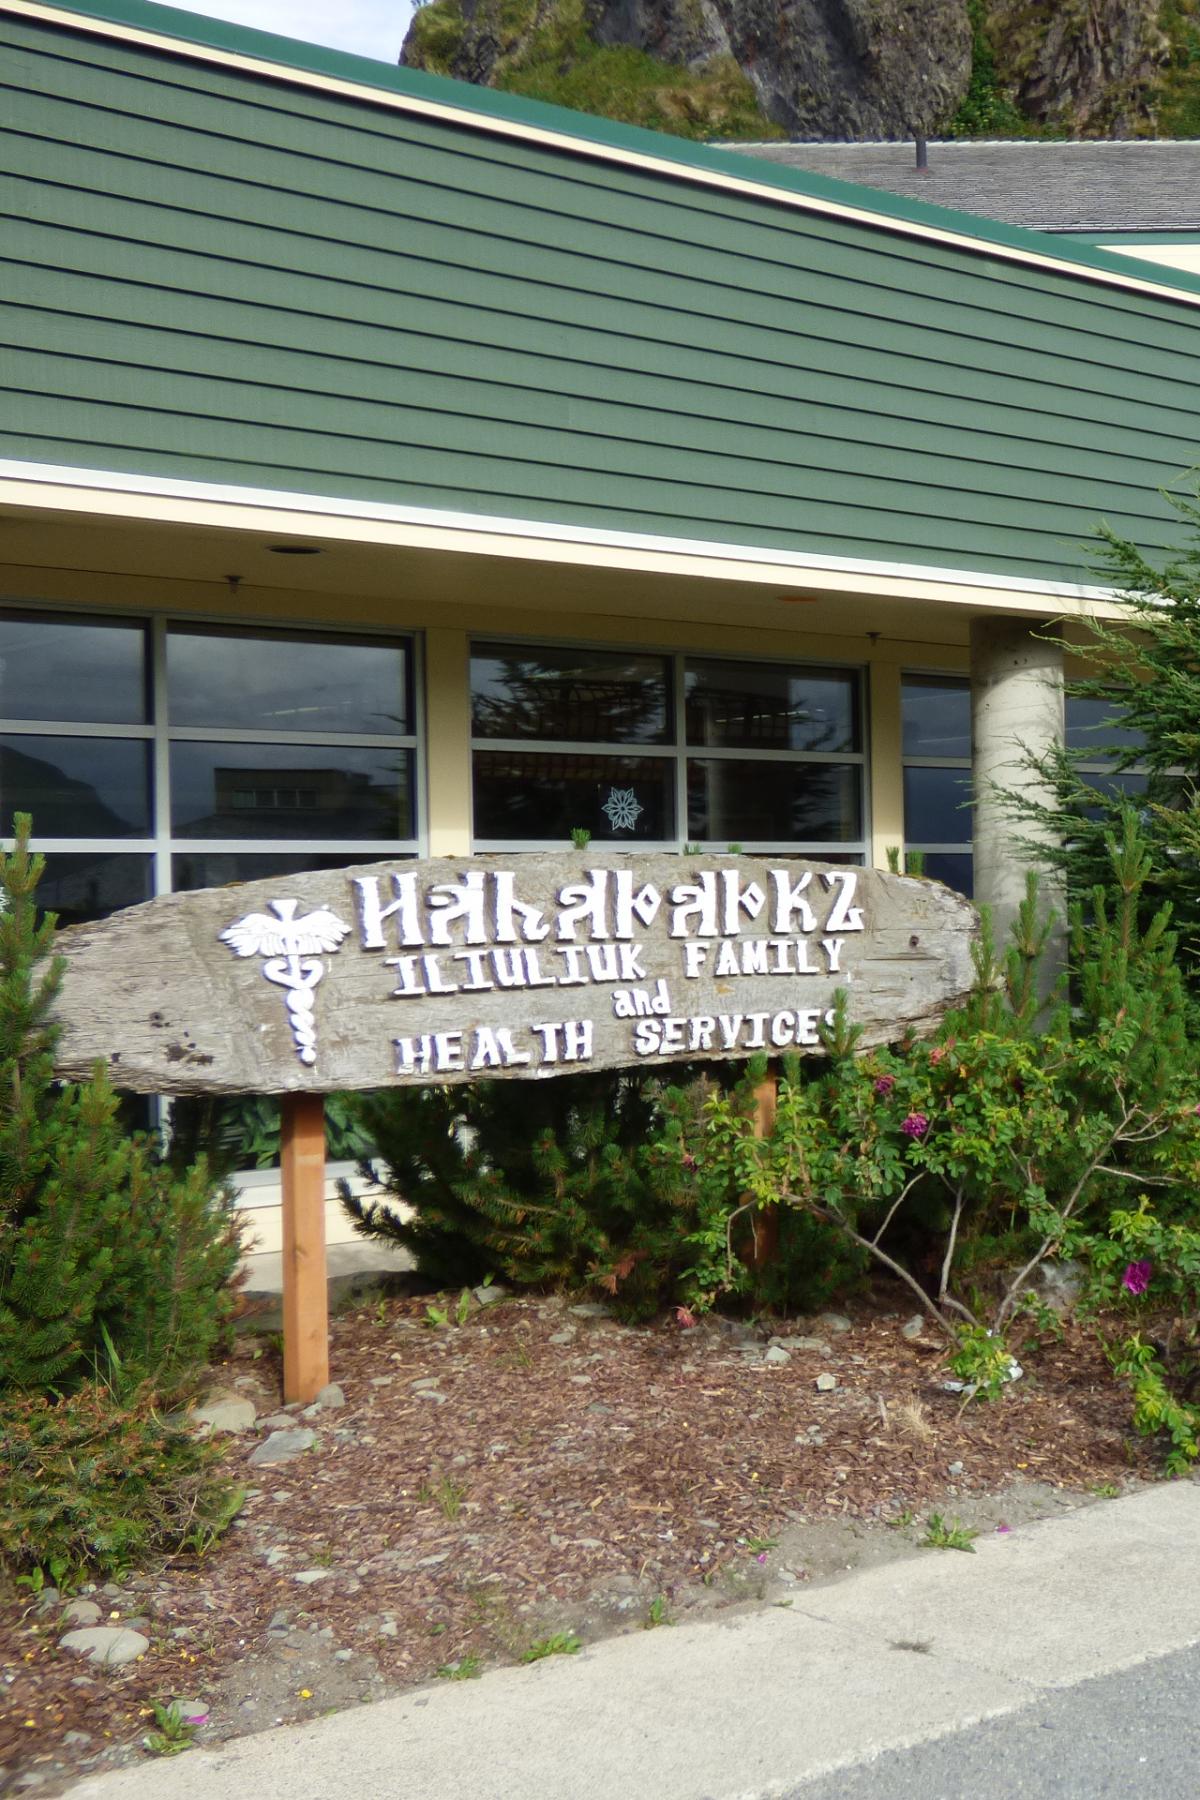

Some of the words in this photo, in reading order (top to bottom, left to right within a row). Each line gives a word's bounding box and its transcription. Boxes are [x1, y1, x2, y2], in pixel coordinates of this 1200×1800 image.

[383, 944, 647, 997] ILIULIUK
[683, 938, 845, 978] FAMILY
[610, 979, 672, 1018] and
[392, 1020, 594, 1076] HEALTH
